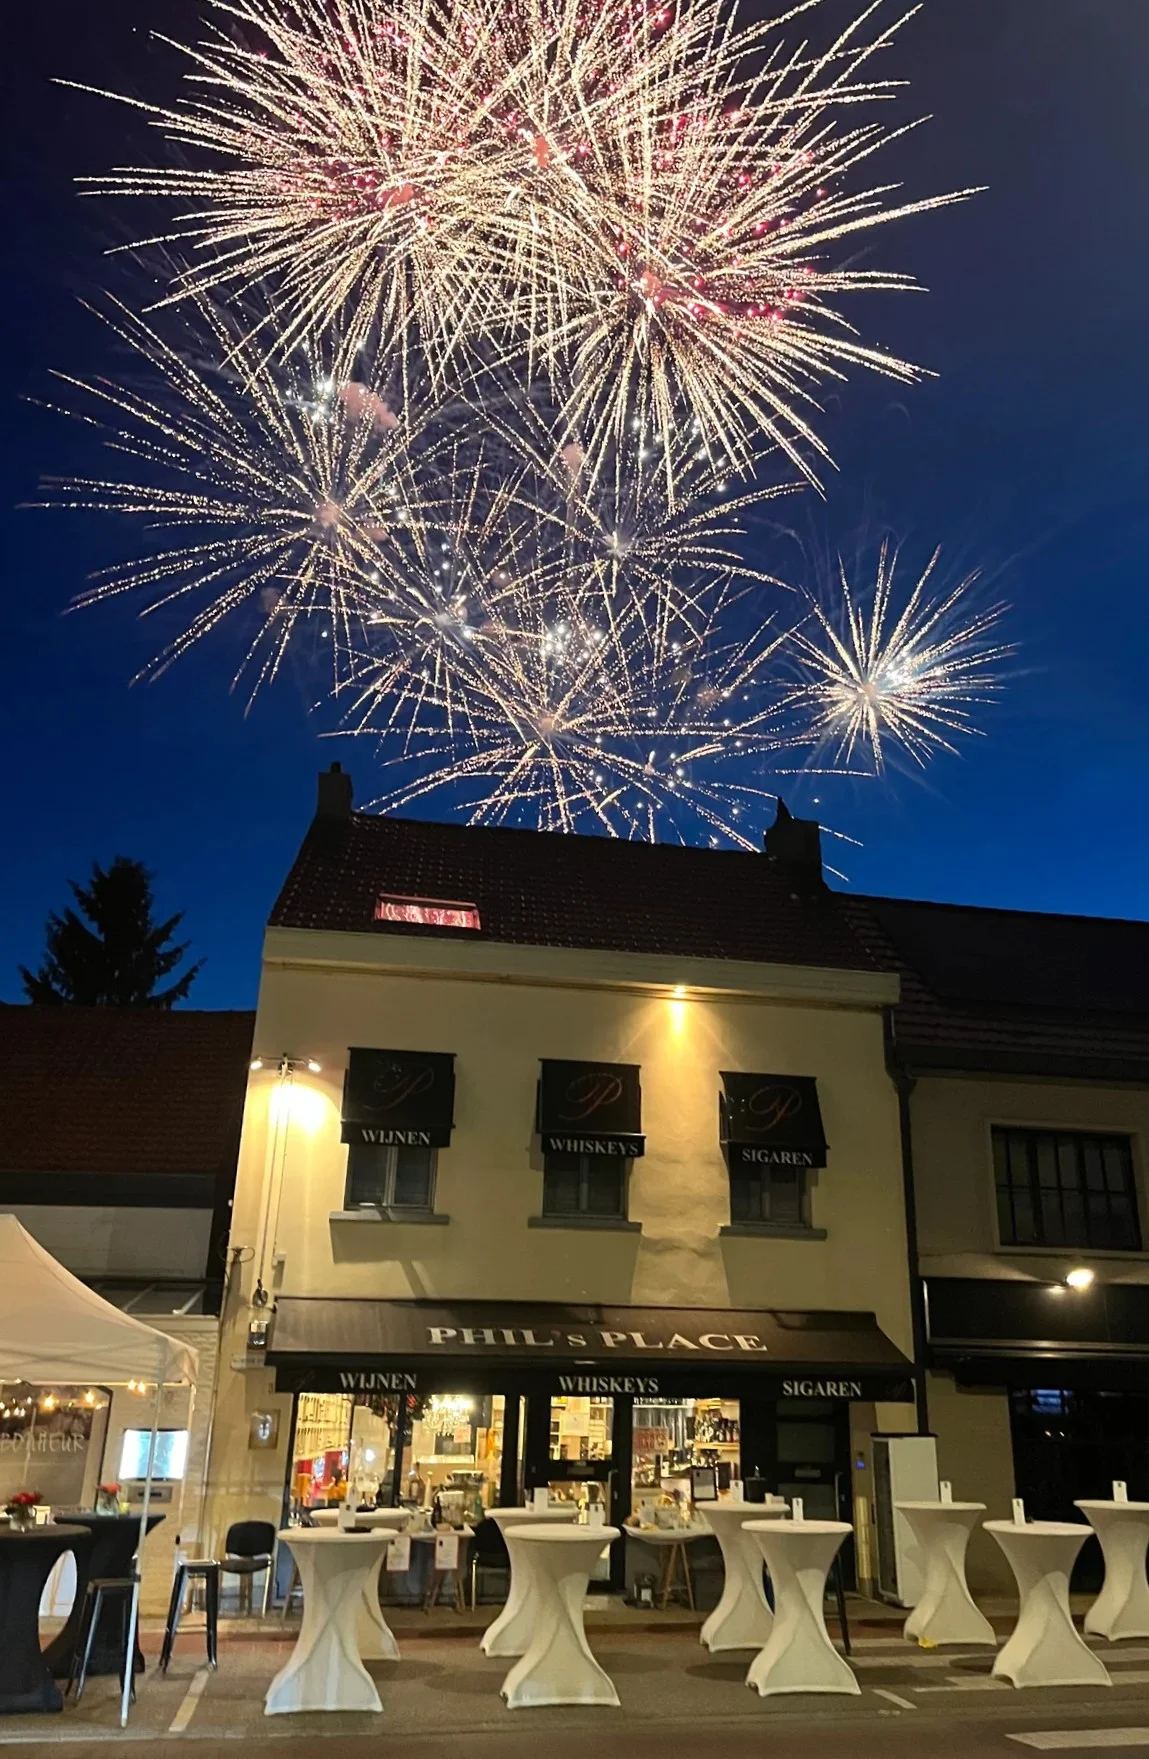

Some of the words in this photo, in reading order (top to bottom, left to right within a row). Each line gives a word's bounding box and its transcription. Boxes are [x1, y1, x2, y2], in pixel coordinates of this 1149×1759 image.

[361, 1128, 431, 1145] WIJNEN
[549, 1137, 639, 1155] WHISKEYS
[742, 1148, 813, 1165] SIGAREN
[600, 1331, 768, 1351] PLACE
[339, 1372, 417, 1389] WIJNEN
[558, 1375, 659, 1393] WHISKEYS
[782, 1380, 861, 1397] SIGAREN
